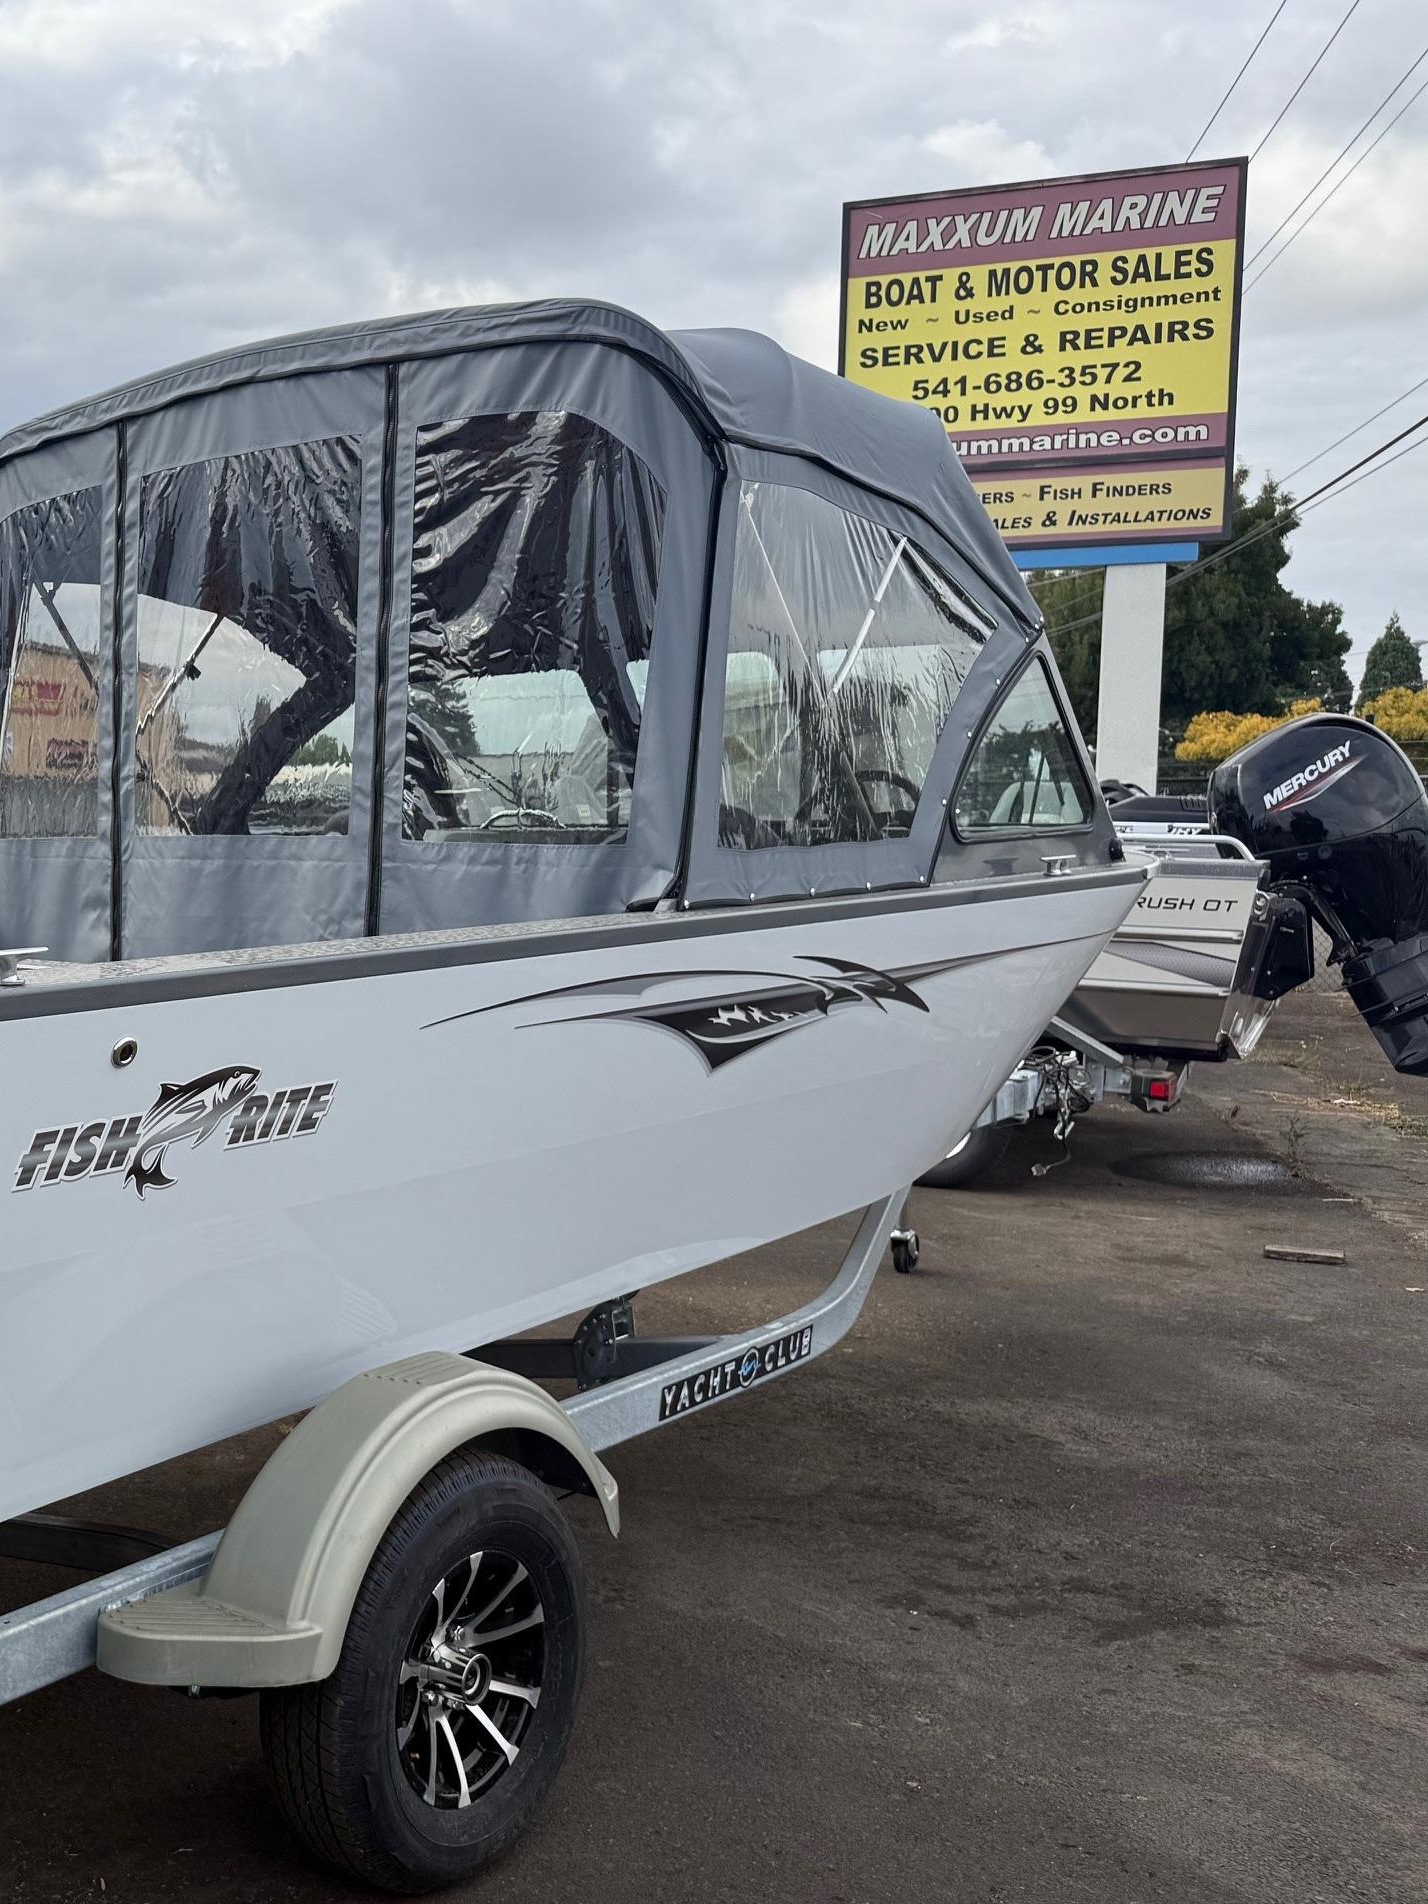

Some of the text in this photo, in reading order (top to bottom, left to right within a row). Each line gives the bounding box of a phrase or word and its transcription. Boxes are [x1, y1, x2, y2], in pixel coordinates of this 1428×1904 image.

[858, 185, 1227, 259] MAXXUM MARINE
[864, 246, 1214, 309] BOAT & MOTOR SALES
[857, 318, 909, 333] New
[954, 304, 1014, 325] Used
[1053, 285, 1222, 316] Consignment
[859, 317, 1215, 369] SERVICE & REPAIRS
[911, 359, 1142, 401] 541-686-3572
[970, 402, 1033, 423] Hwy
[1042, 395, 1078, 416] 99
[1089, 387, 1174, 412] North
[951, 423, 1209, 457] ummarine.com
[978, 491, 1014, 505] ERS
[1041, 510, 1058, 528] &
[1262, 740, 1351, 810] MERCURY
[1202, 899, 1239, 912] OT
[14, 1080, 337, 1188] FISH RITE
[663, 1327, 812, 1417] YACHT CLUB
